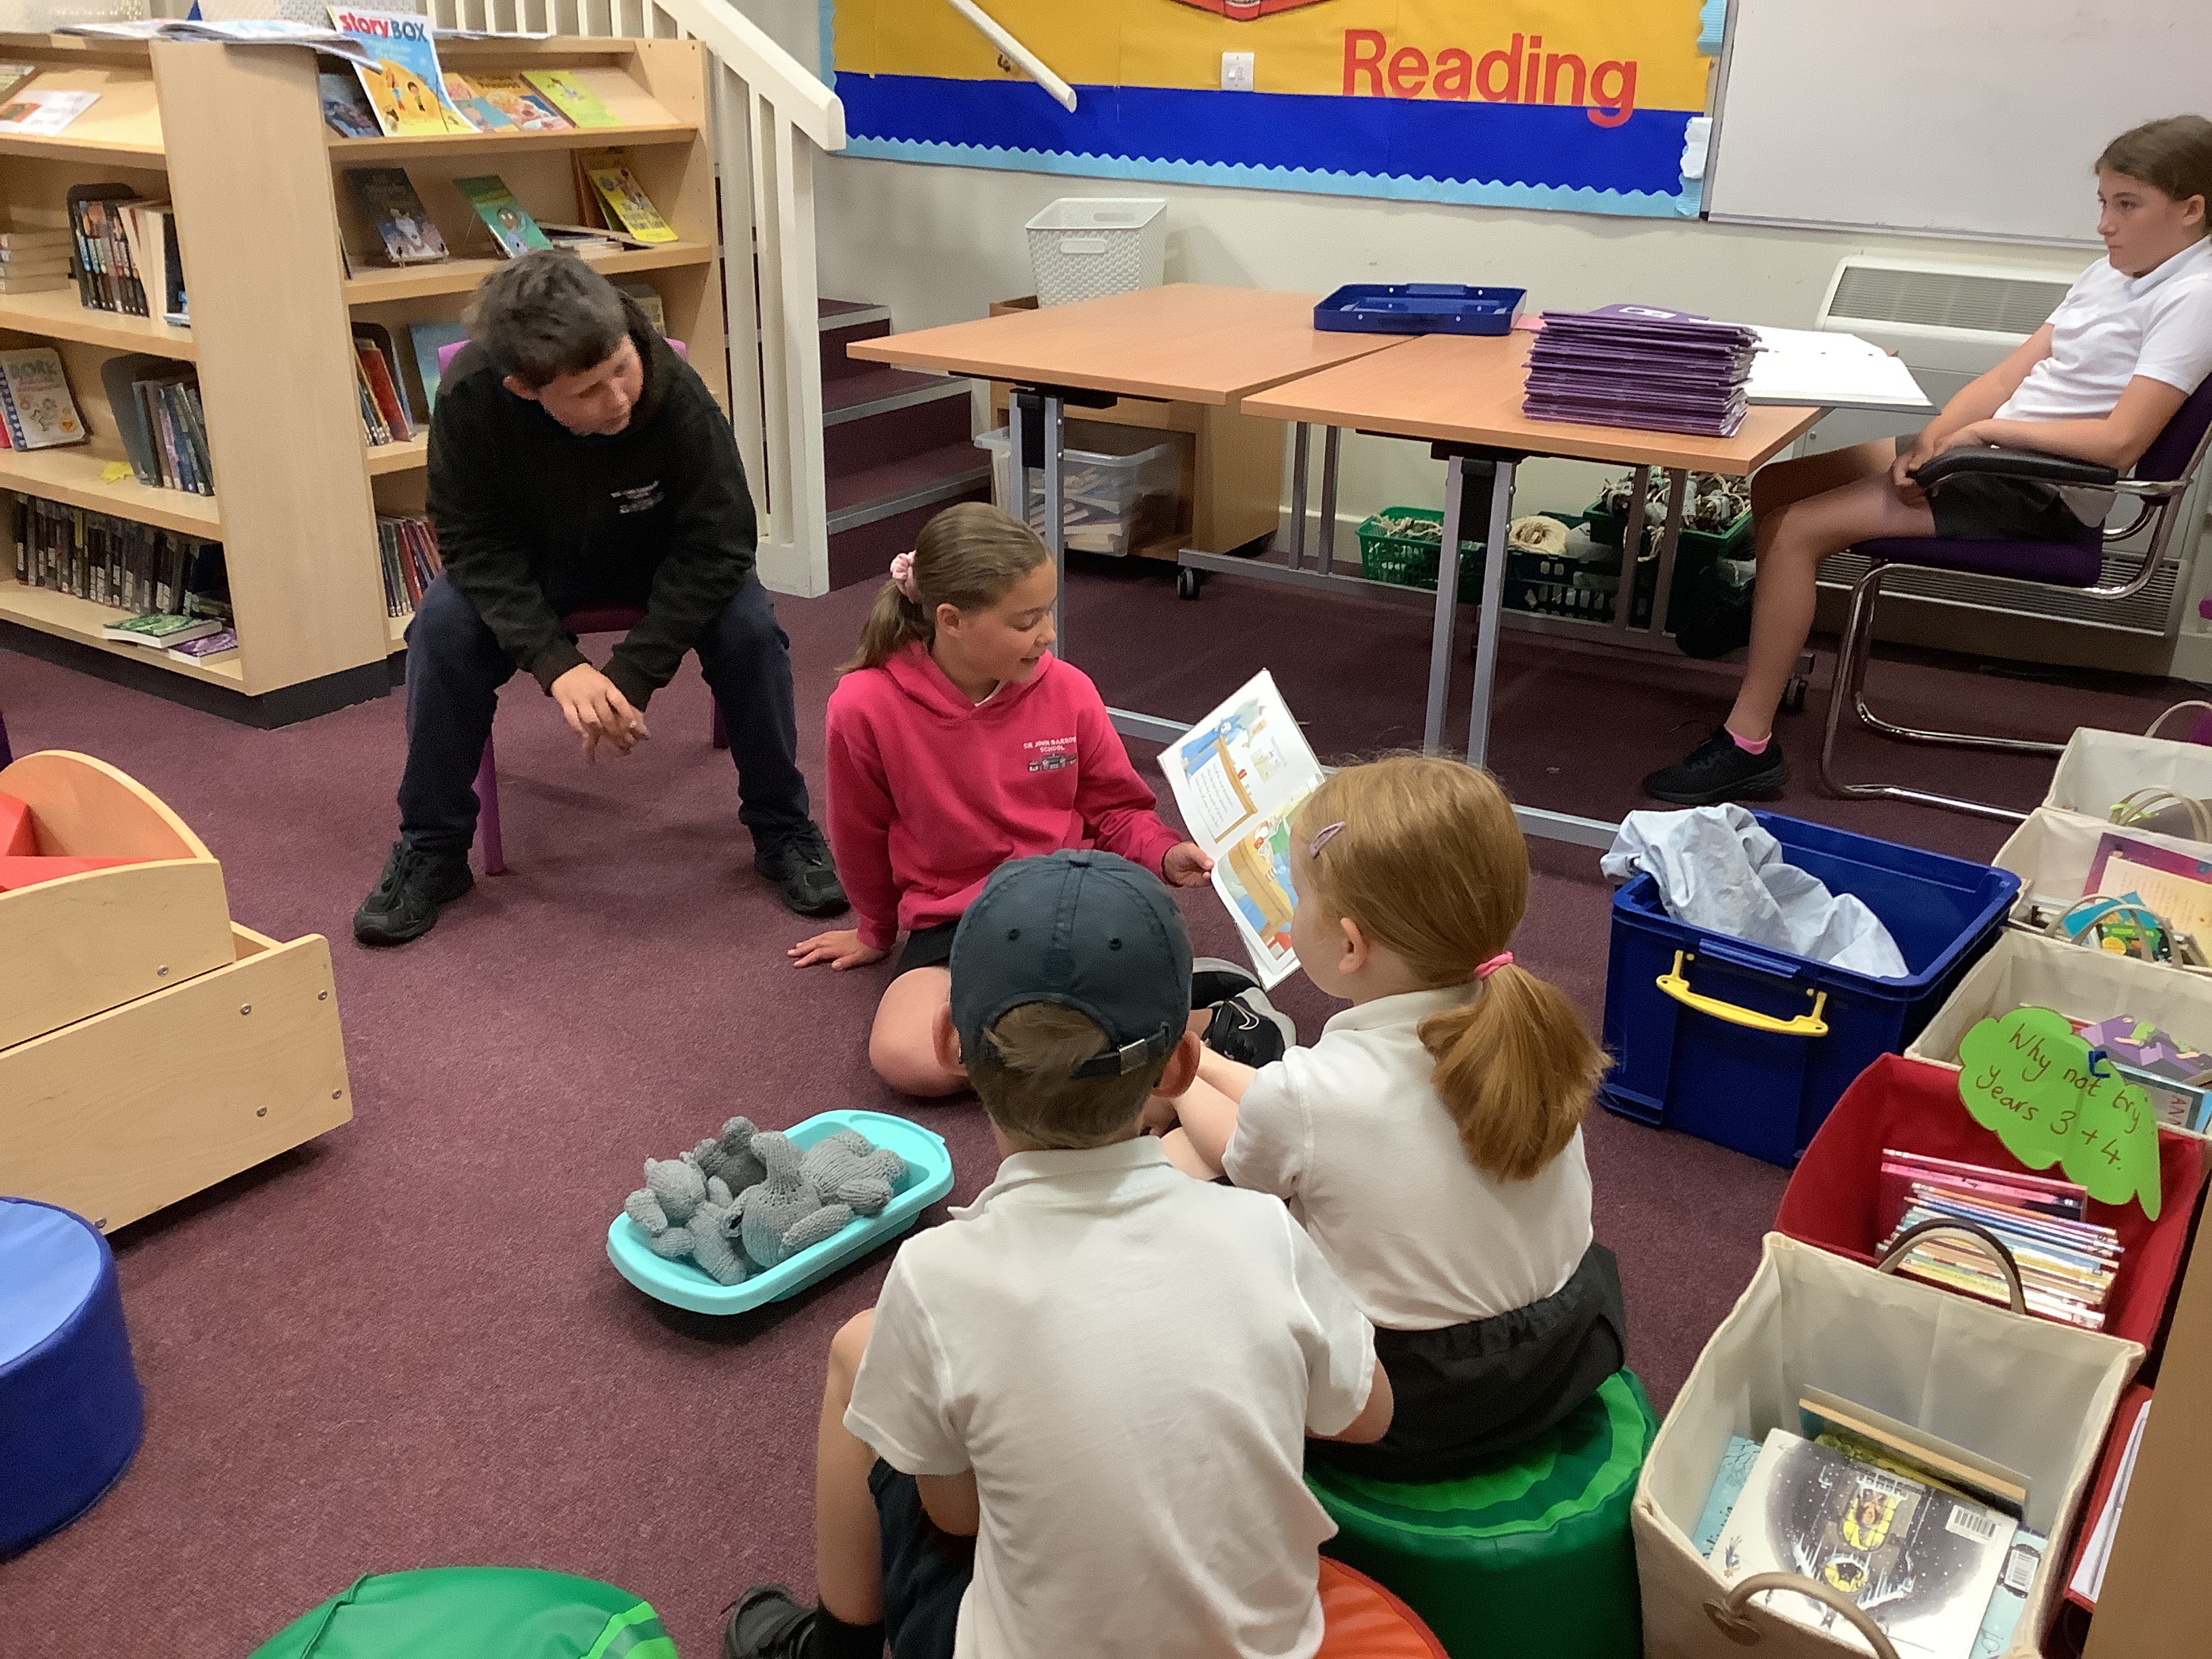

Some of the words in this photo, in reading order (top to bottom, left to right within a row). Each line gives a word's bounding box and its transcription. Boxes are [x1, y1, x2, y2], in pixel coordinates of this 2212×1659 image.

[1340, 28, 1637, 128] Reading
[1975, 1065, 2039, 1122] years
[2050, 1110, 2076, 1134] 3
[2009, 1023, 2052, 1082] Why
[2062, 1067, 2102, 1097] not
[2112, 1089, 2142, 1134] try
